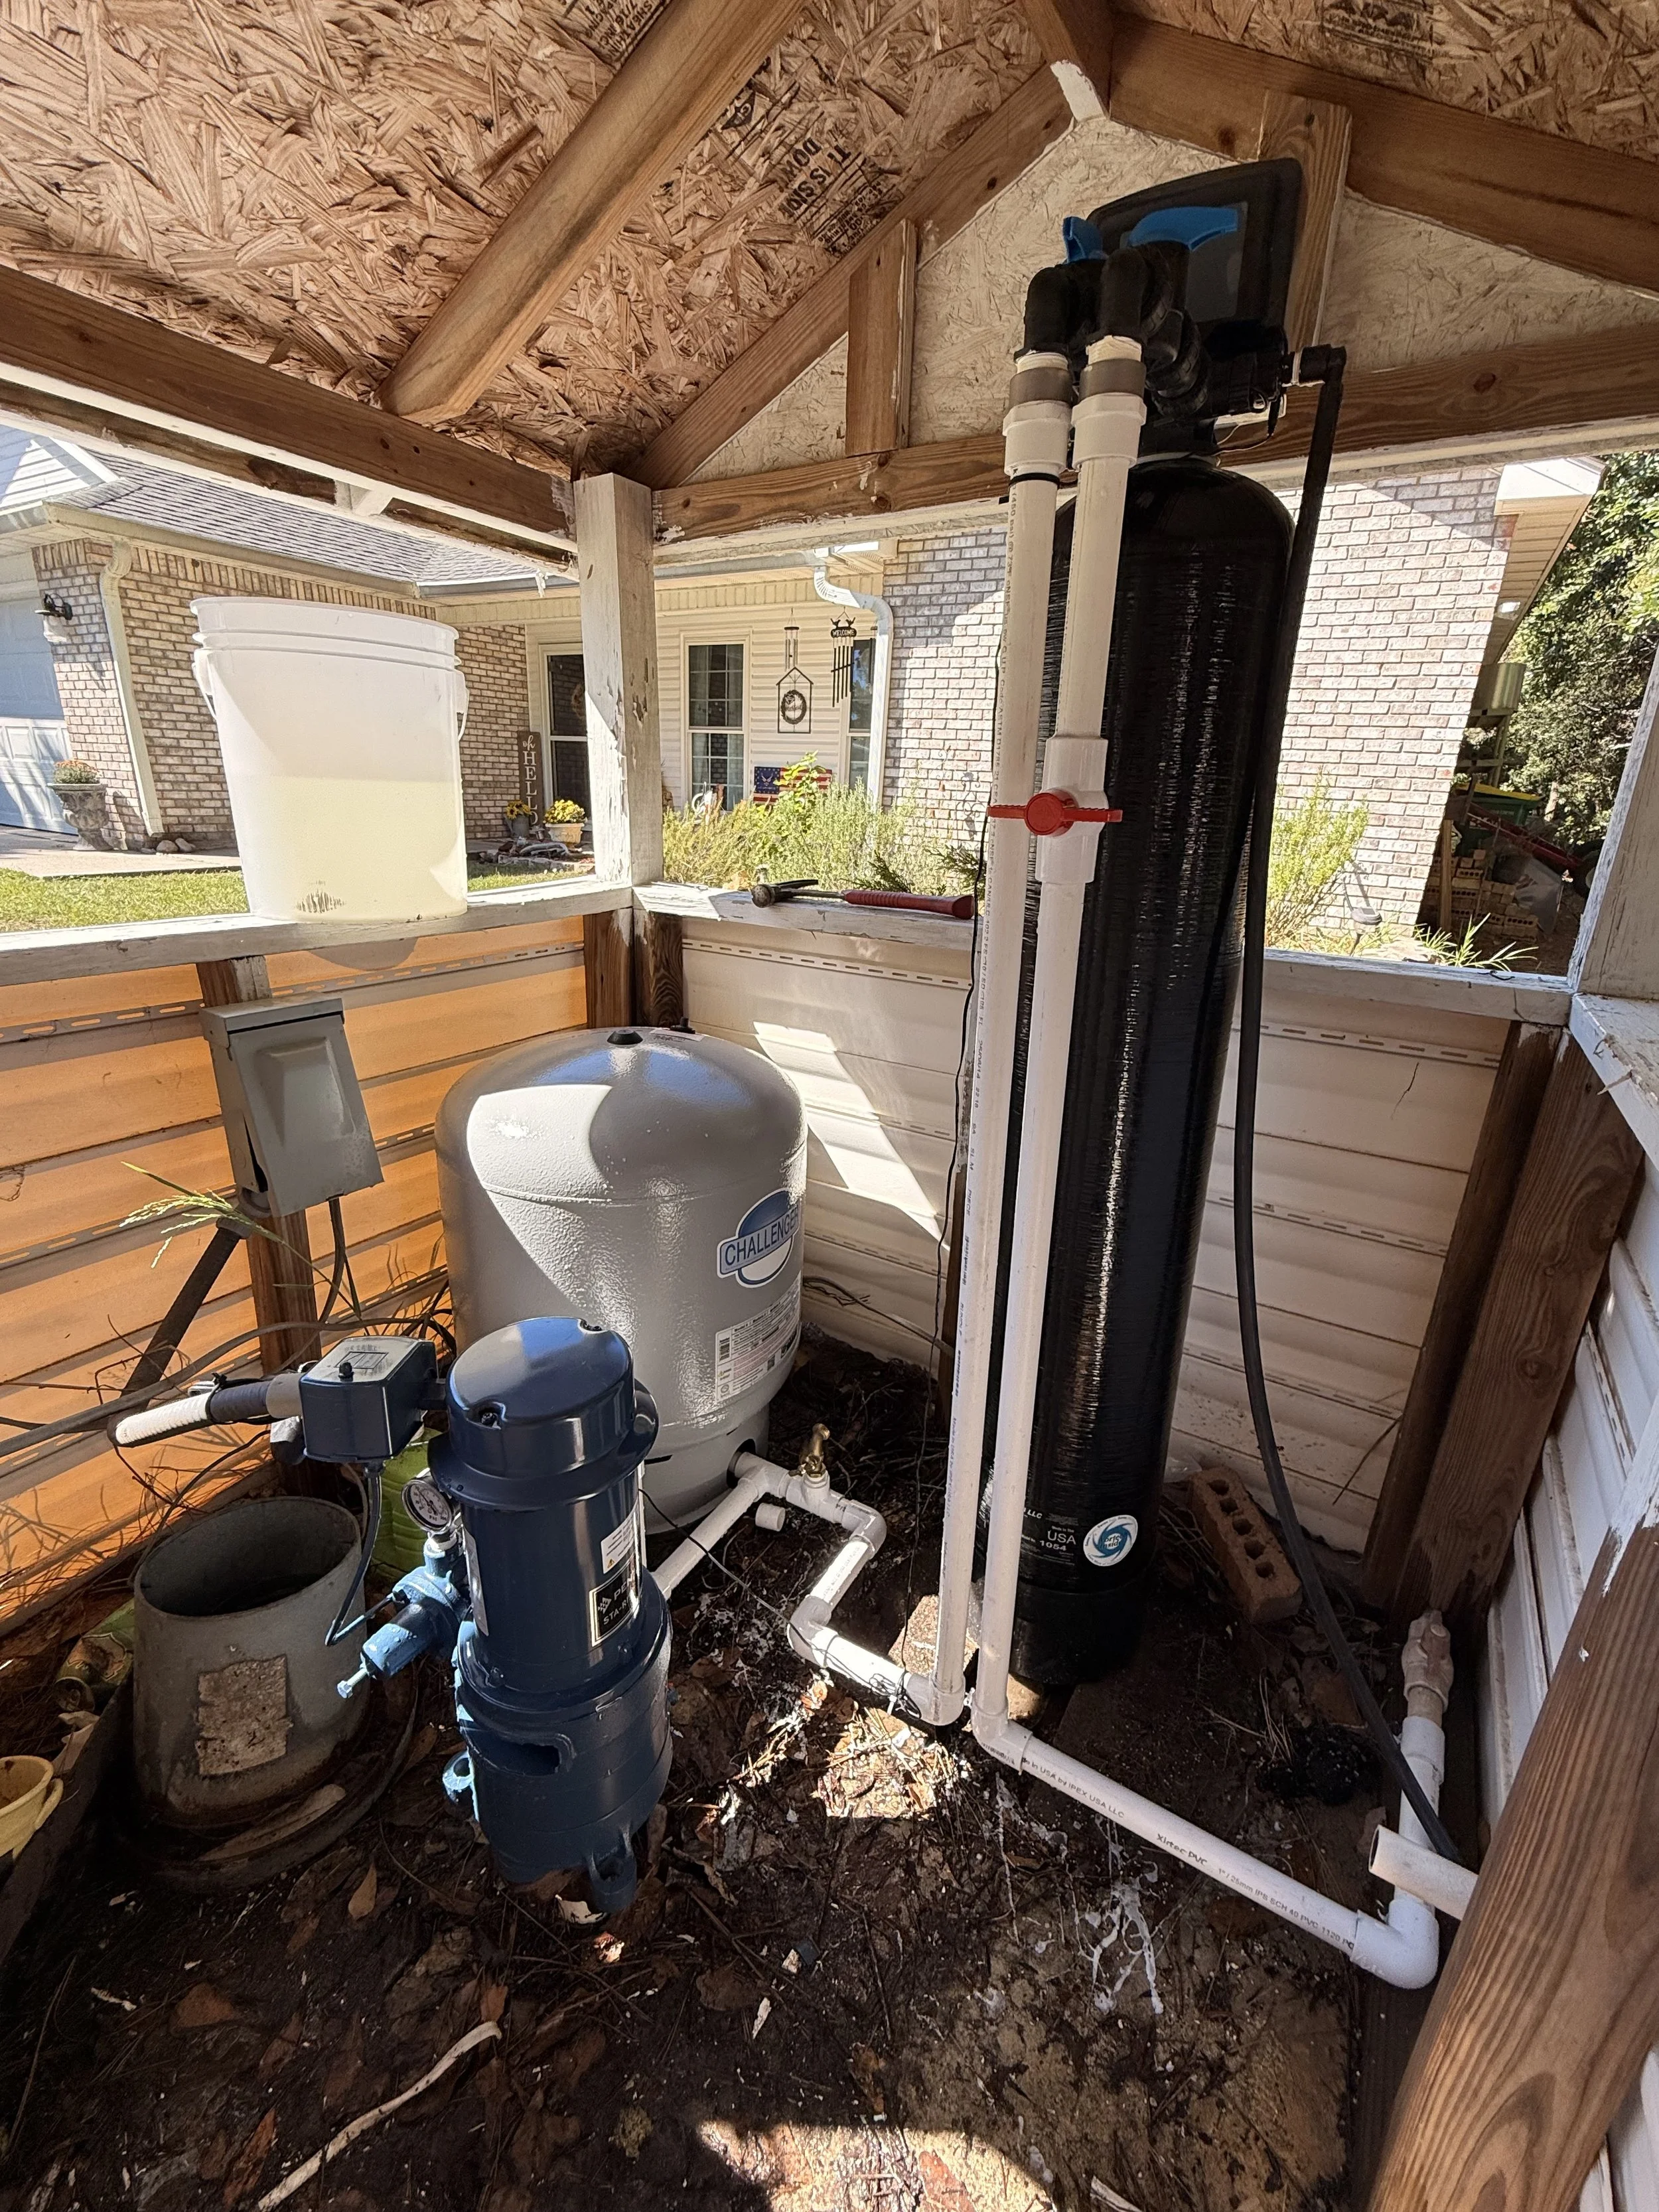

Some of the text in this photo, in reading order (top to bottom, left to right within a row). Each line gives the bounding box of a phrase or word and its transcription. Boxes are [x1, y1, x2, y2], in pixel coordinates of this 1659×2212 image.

[832, 628, 855, 637] WELCOME
[522, 735, 536, 751] oh
[725, 1205, 800, 1266] CHALLENGER
[1027, 1509, 1043, 1519] LLC
[1047, 1530, 1076, 1545] USA
[1039, 1540, 1066, 1551] 1054
[1039, 1766, 1058, 1781] USA
[1067, 1782, 1088, 1797] IPEX
[1088, 1794, 1108, 1808] USA
[1107, 1805, 1125, 1818] LLC
[1187, 1850, 1208, 1867] PVC
[1268, 1897, 1289, 1912] SCH
[1299, 1913, 1320, 1930] PVC
[1319, 1925, 1342, 1943] 1120
